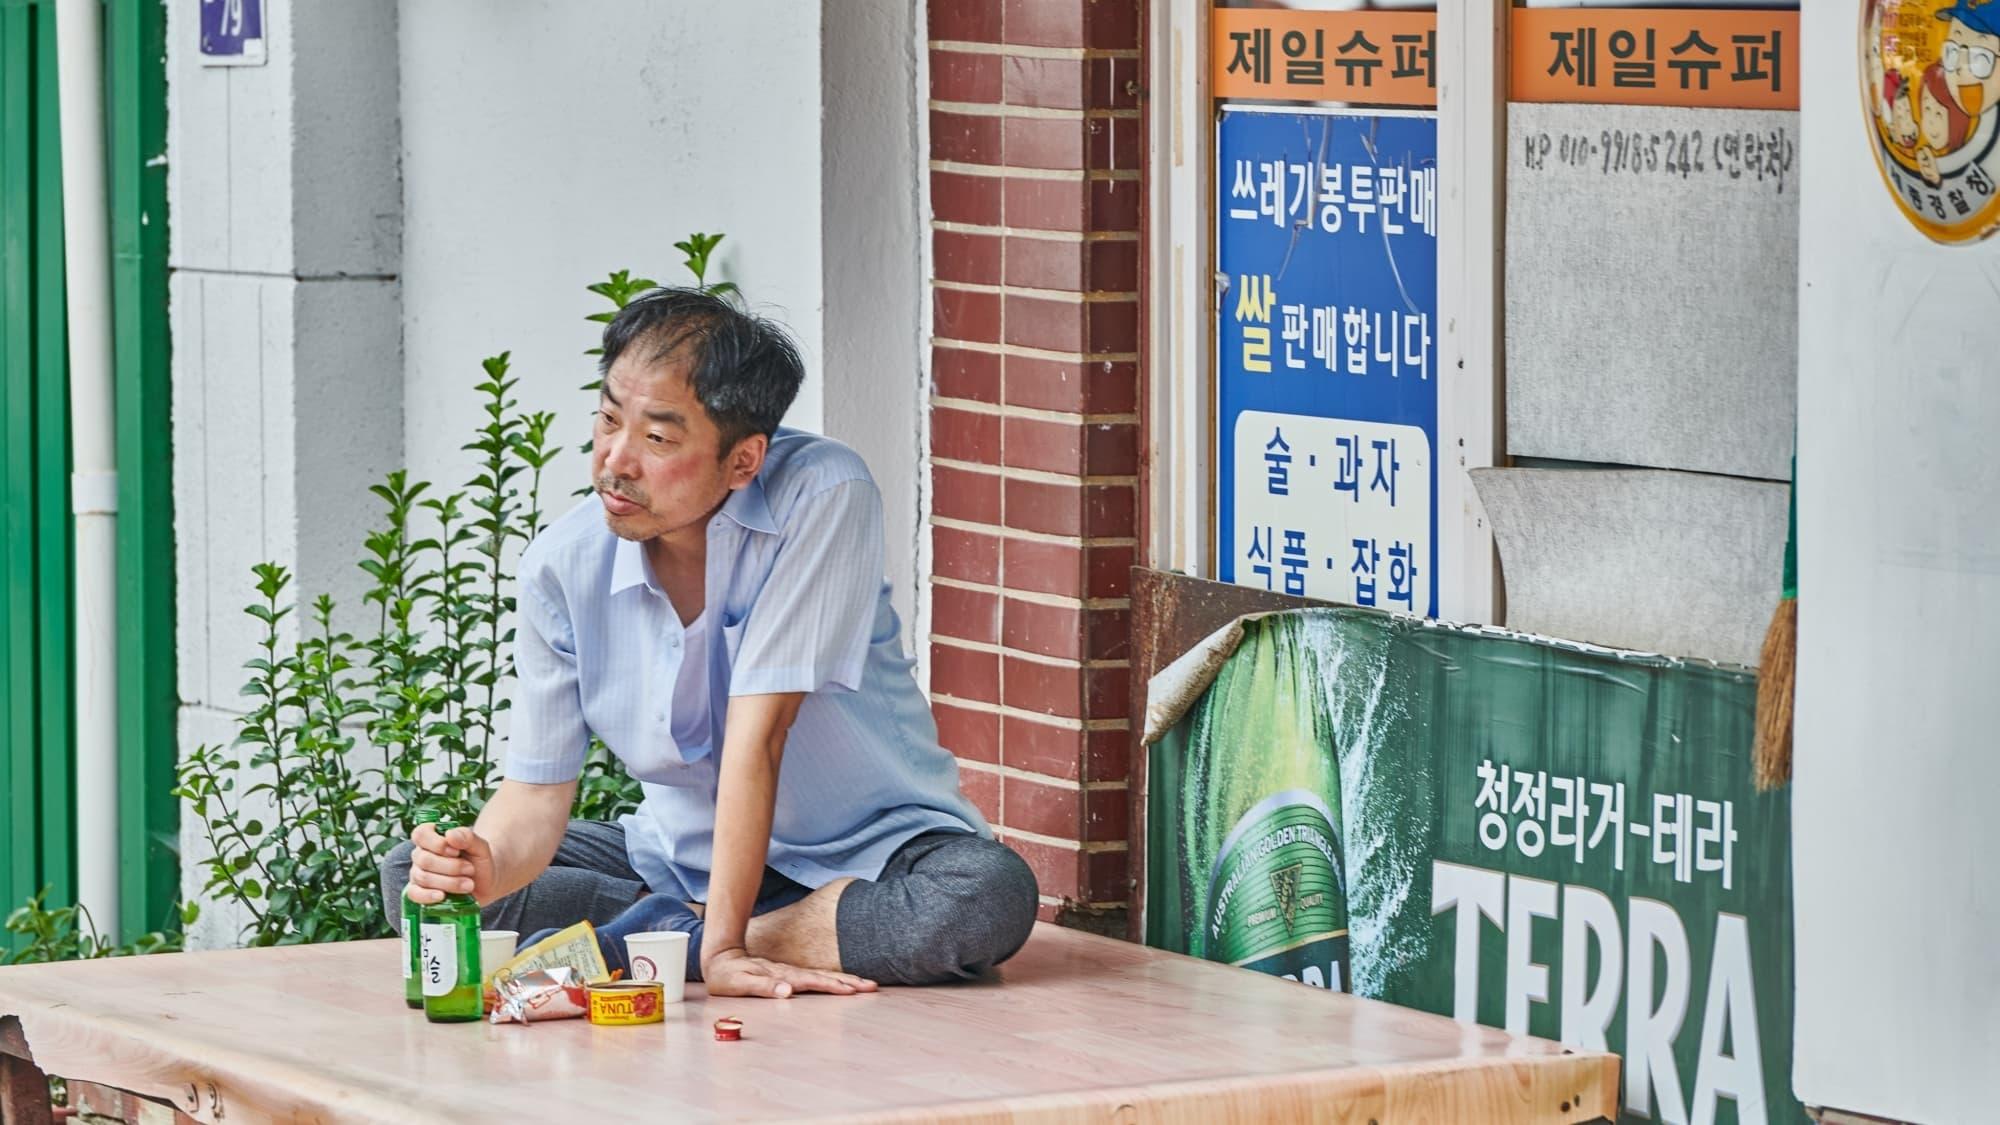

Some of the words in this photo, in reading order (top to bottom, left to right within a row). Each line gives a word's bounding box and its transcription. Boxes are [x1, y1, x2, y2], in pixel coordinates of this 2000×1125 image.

[1227, 28, 1436, 88] 제일슈퍼
[1547, 28, 1782, 92] 제일슈퍼
[1230, 159, 1436, 237] 쓰레기봉투판매
[1235, 274, 1276, 373] 쌀
[1281, 303, 1431, 380] 판매합니다
[1475, 759, 1738, 890] 청정라거-테라
[599, 1002, 633, 1015] TUNA
[1431, 859, 1768, 1125] TERRA
